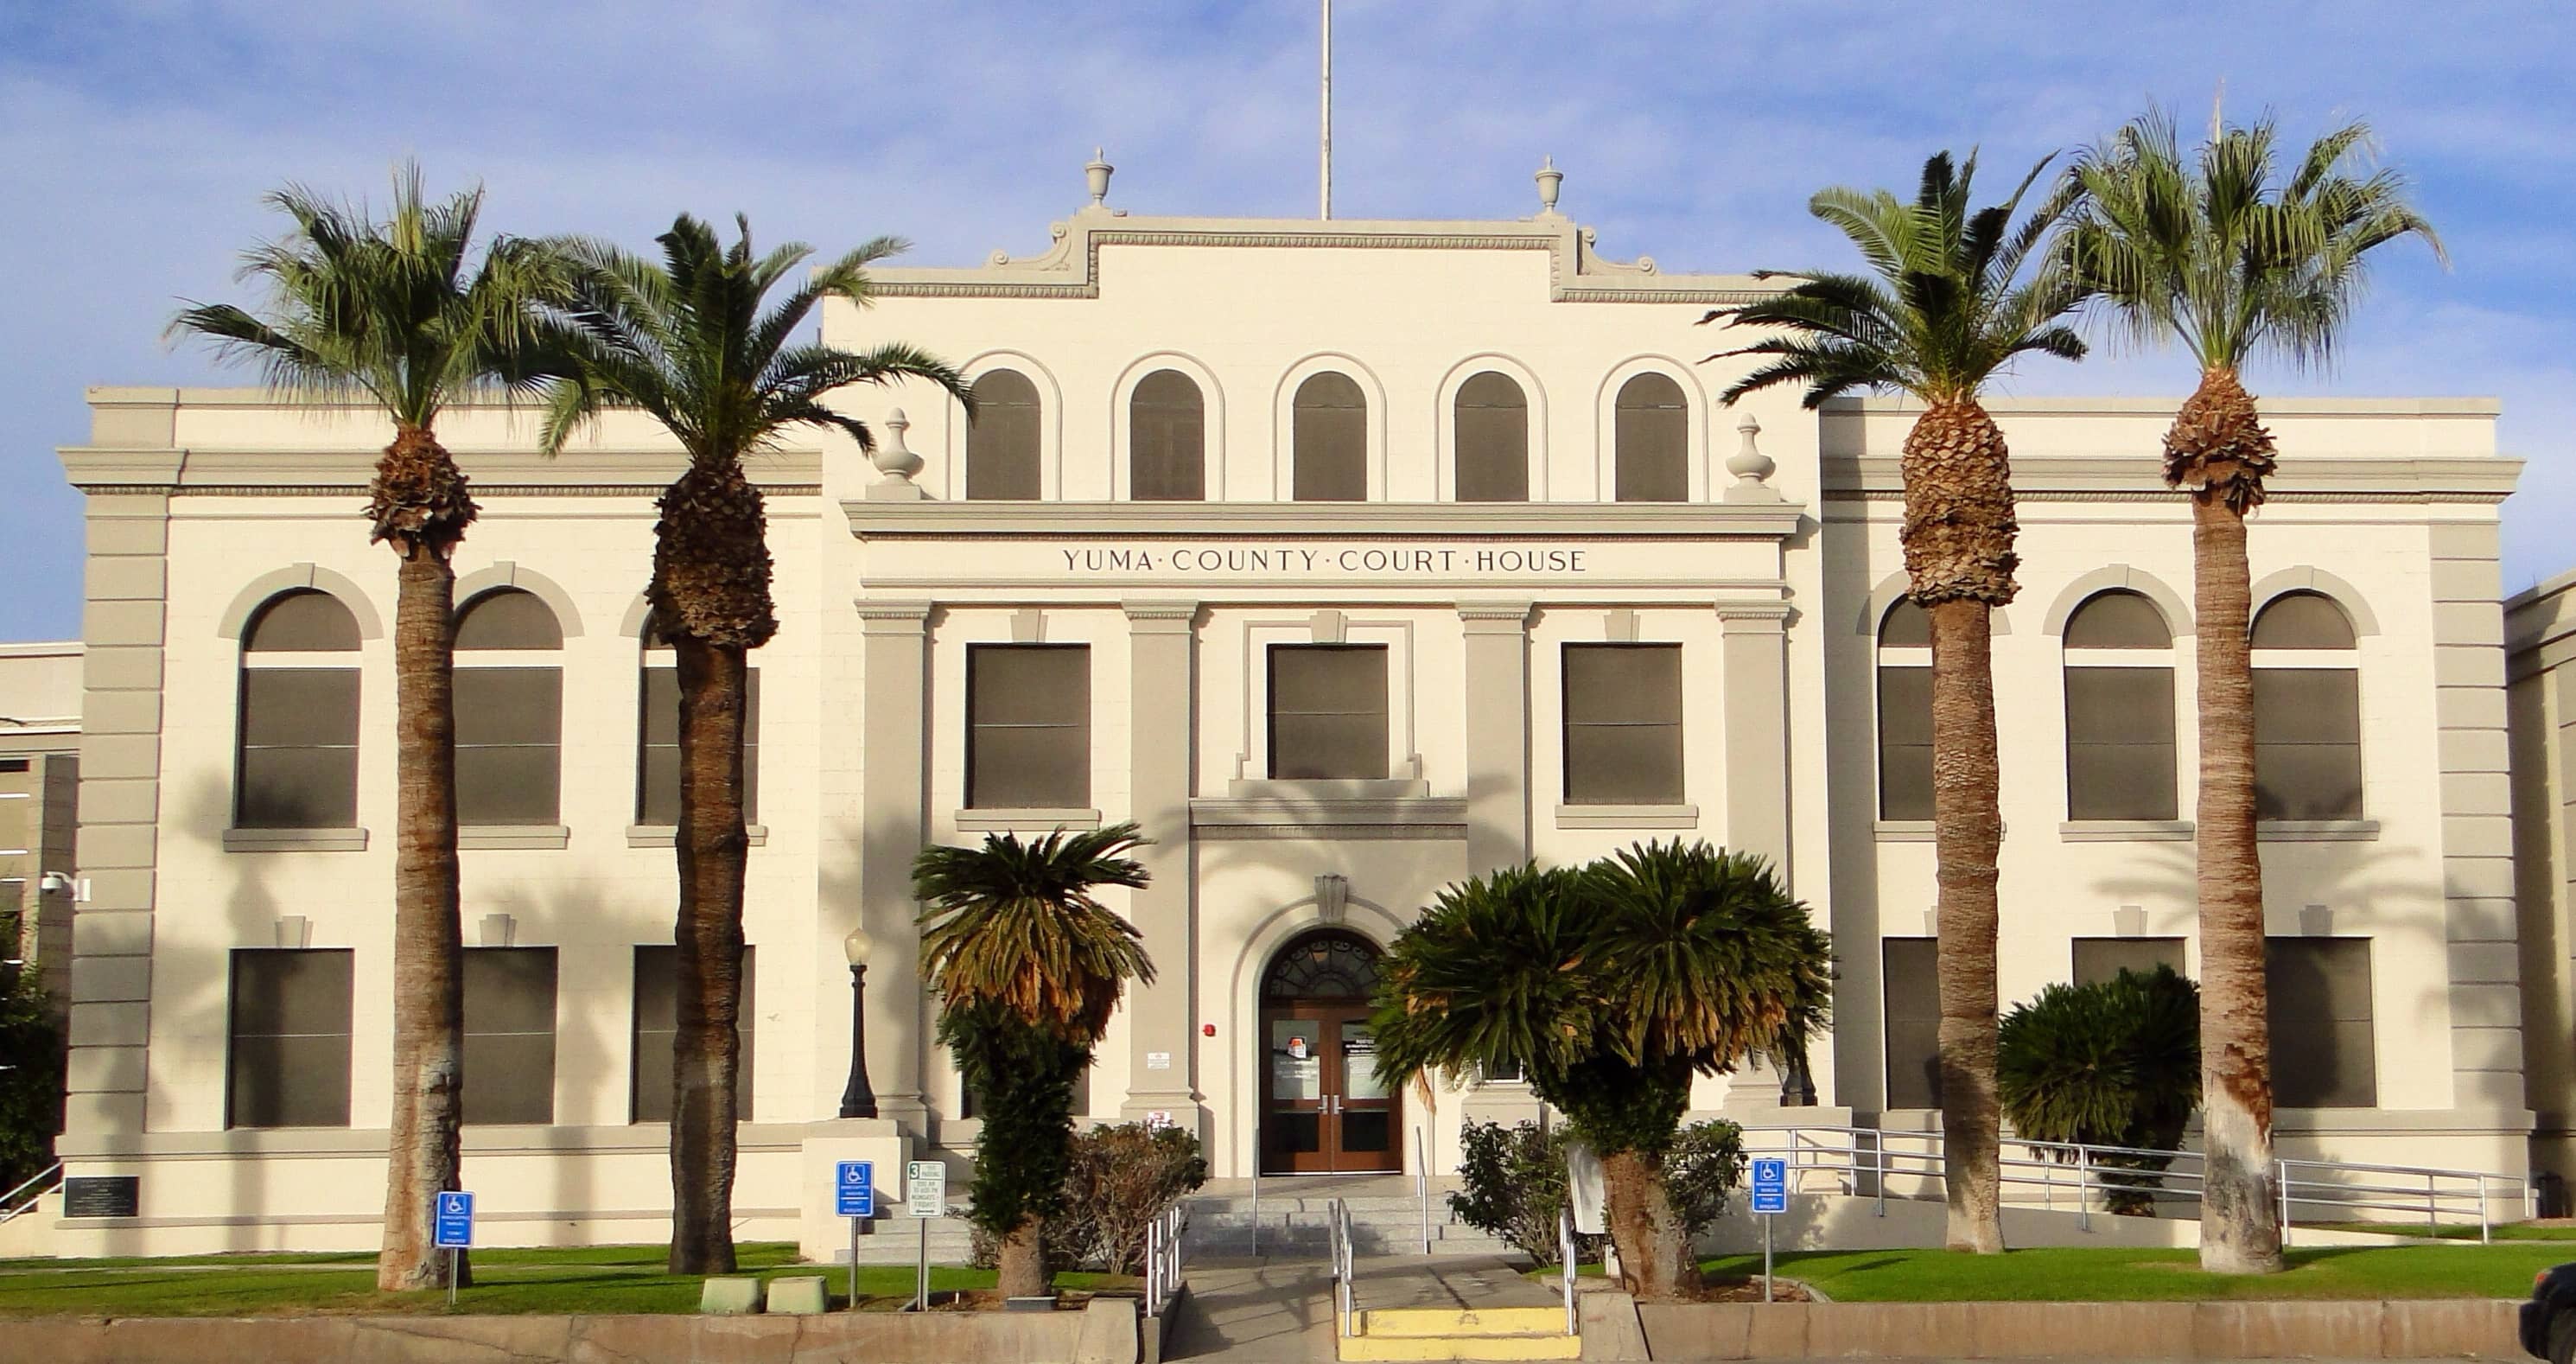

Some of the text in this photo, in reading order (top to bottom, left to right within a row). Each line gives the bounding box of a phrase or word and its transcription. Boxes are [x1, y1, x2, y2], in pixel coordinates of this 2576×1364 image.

[1063, 549, 1587, 572] YUMA COUNTY COURT HOUSE
[910, 1164, 919, 1178] 3
